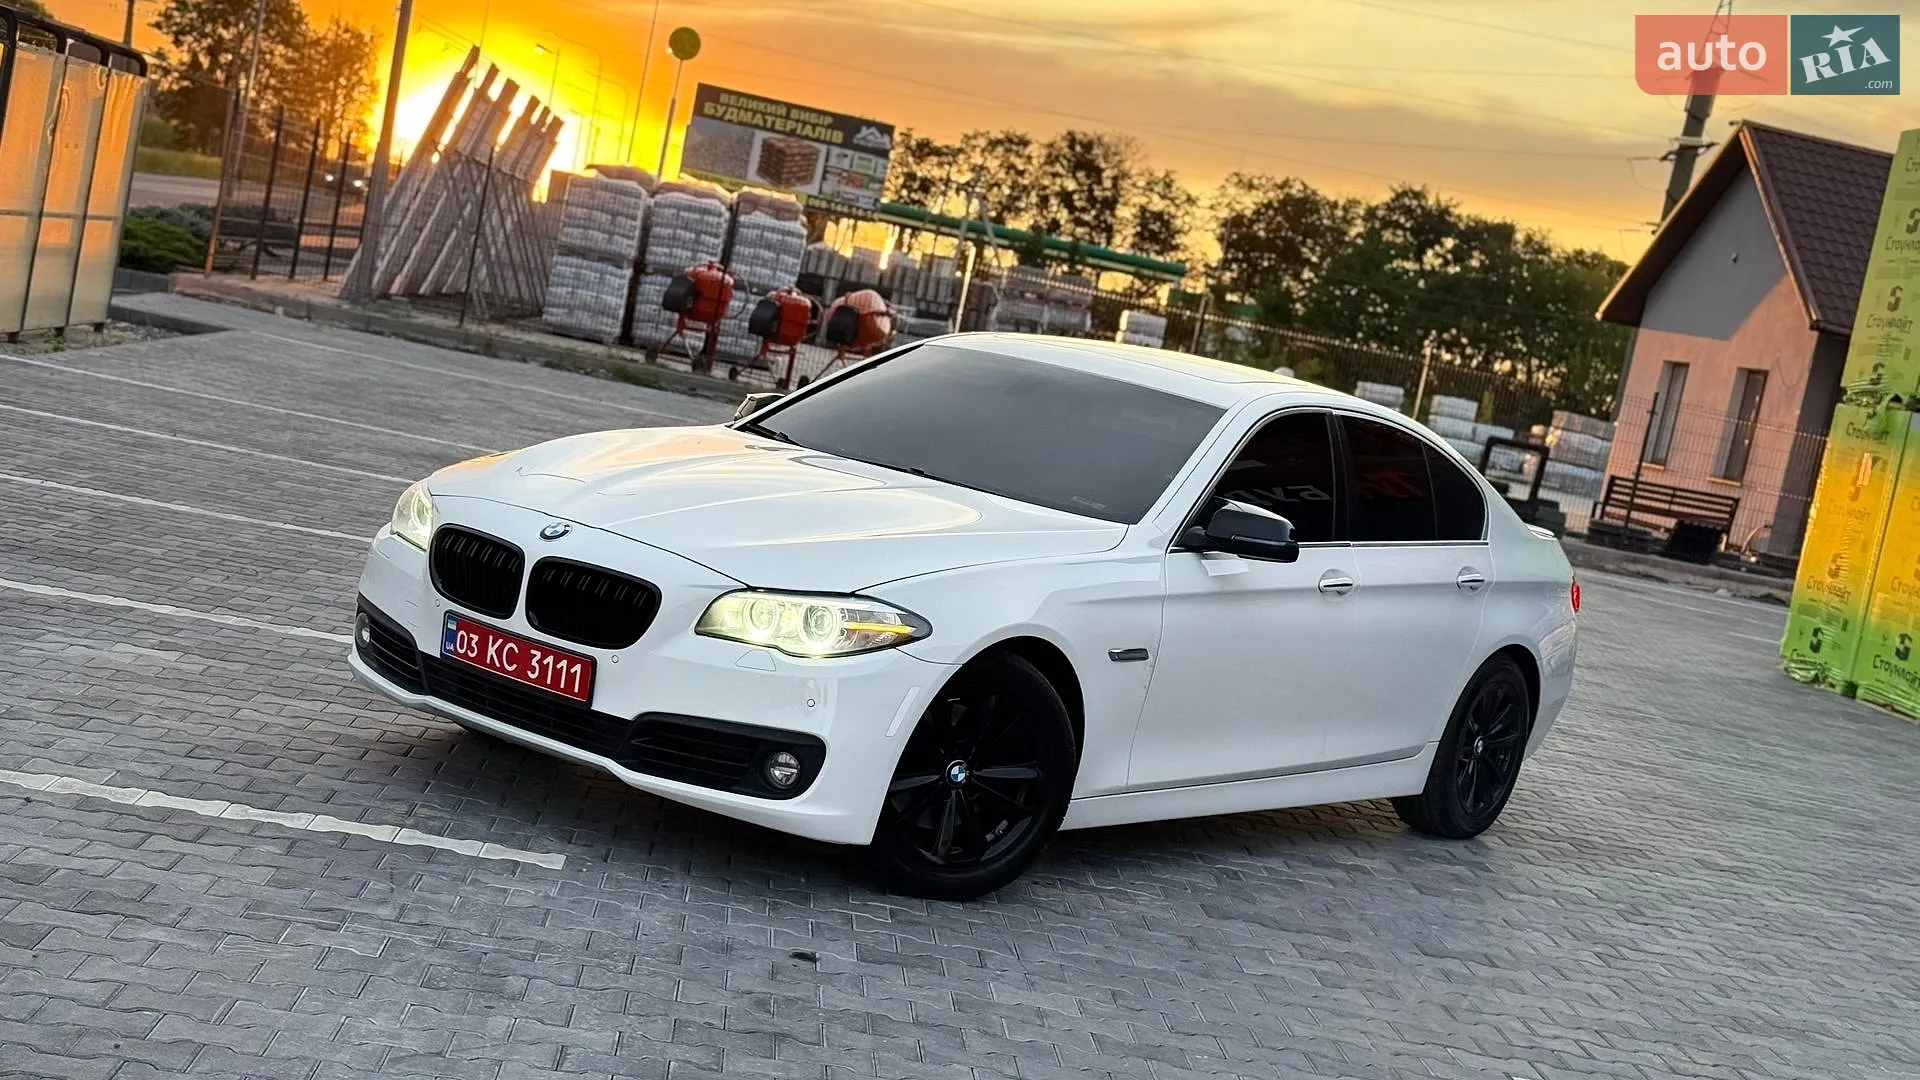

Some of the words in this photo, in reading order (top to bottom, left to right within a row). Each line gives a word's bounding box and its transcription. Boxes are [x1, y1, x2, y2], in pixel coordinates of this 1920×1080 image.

[703, 102, 844, 144] БУДМАТЕРІАЛІВ
[719, 92, 788, 120] ВЕЛИКИЙ
[790, 106, 833, 127] ВИБІР
[456, 630, 479, 658] 03
[486, 635, 519, 672] KC
[526, 649, 582, 693] 3111
